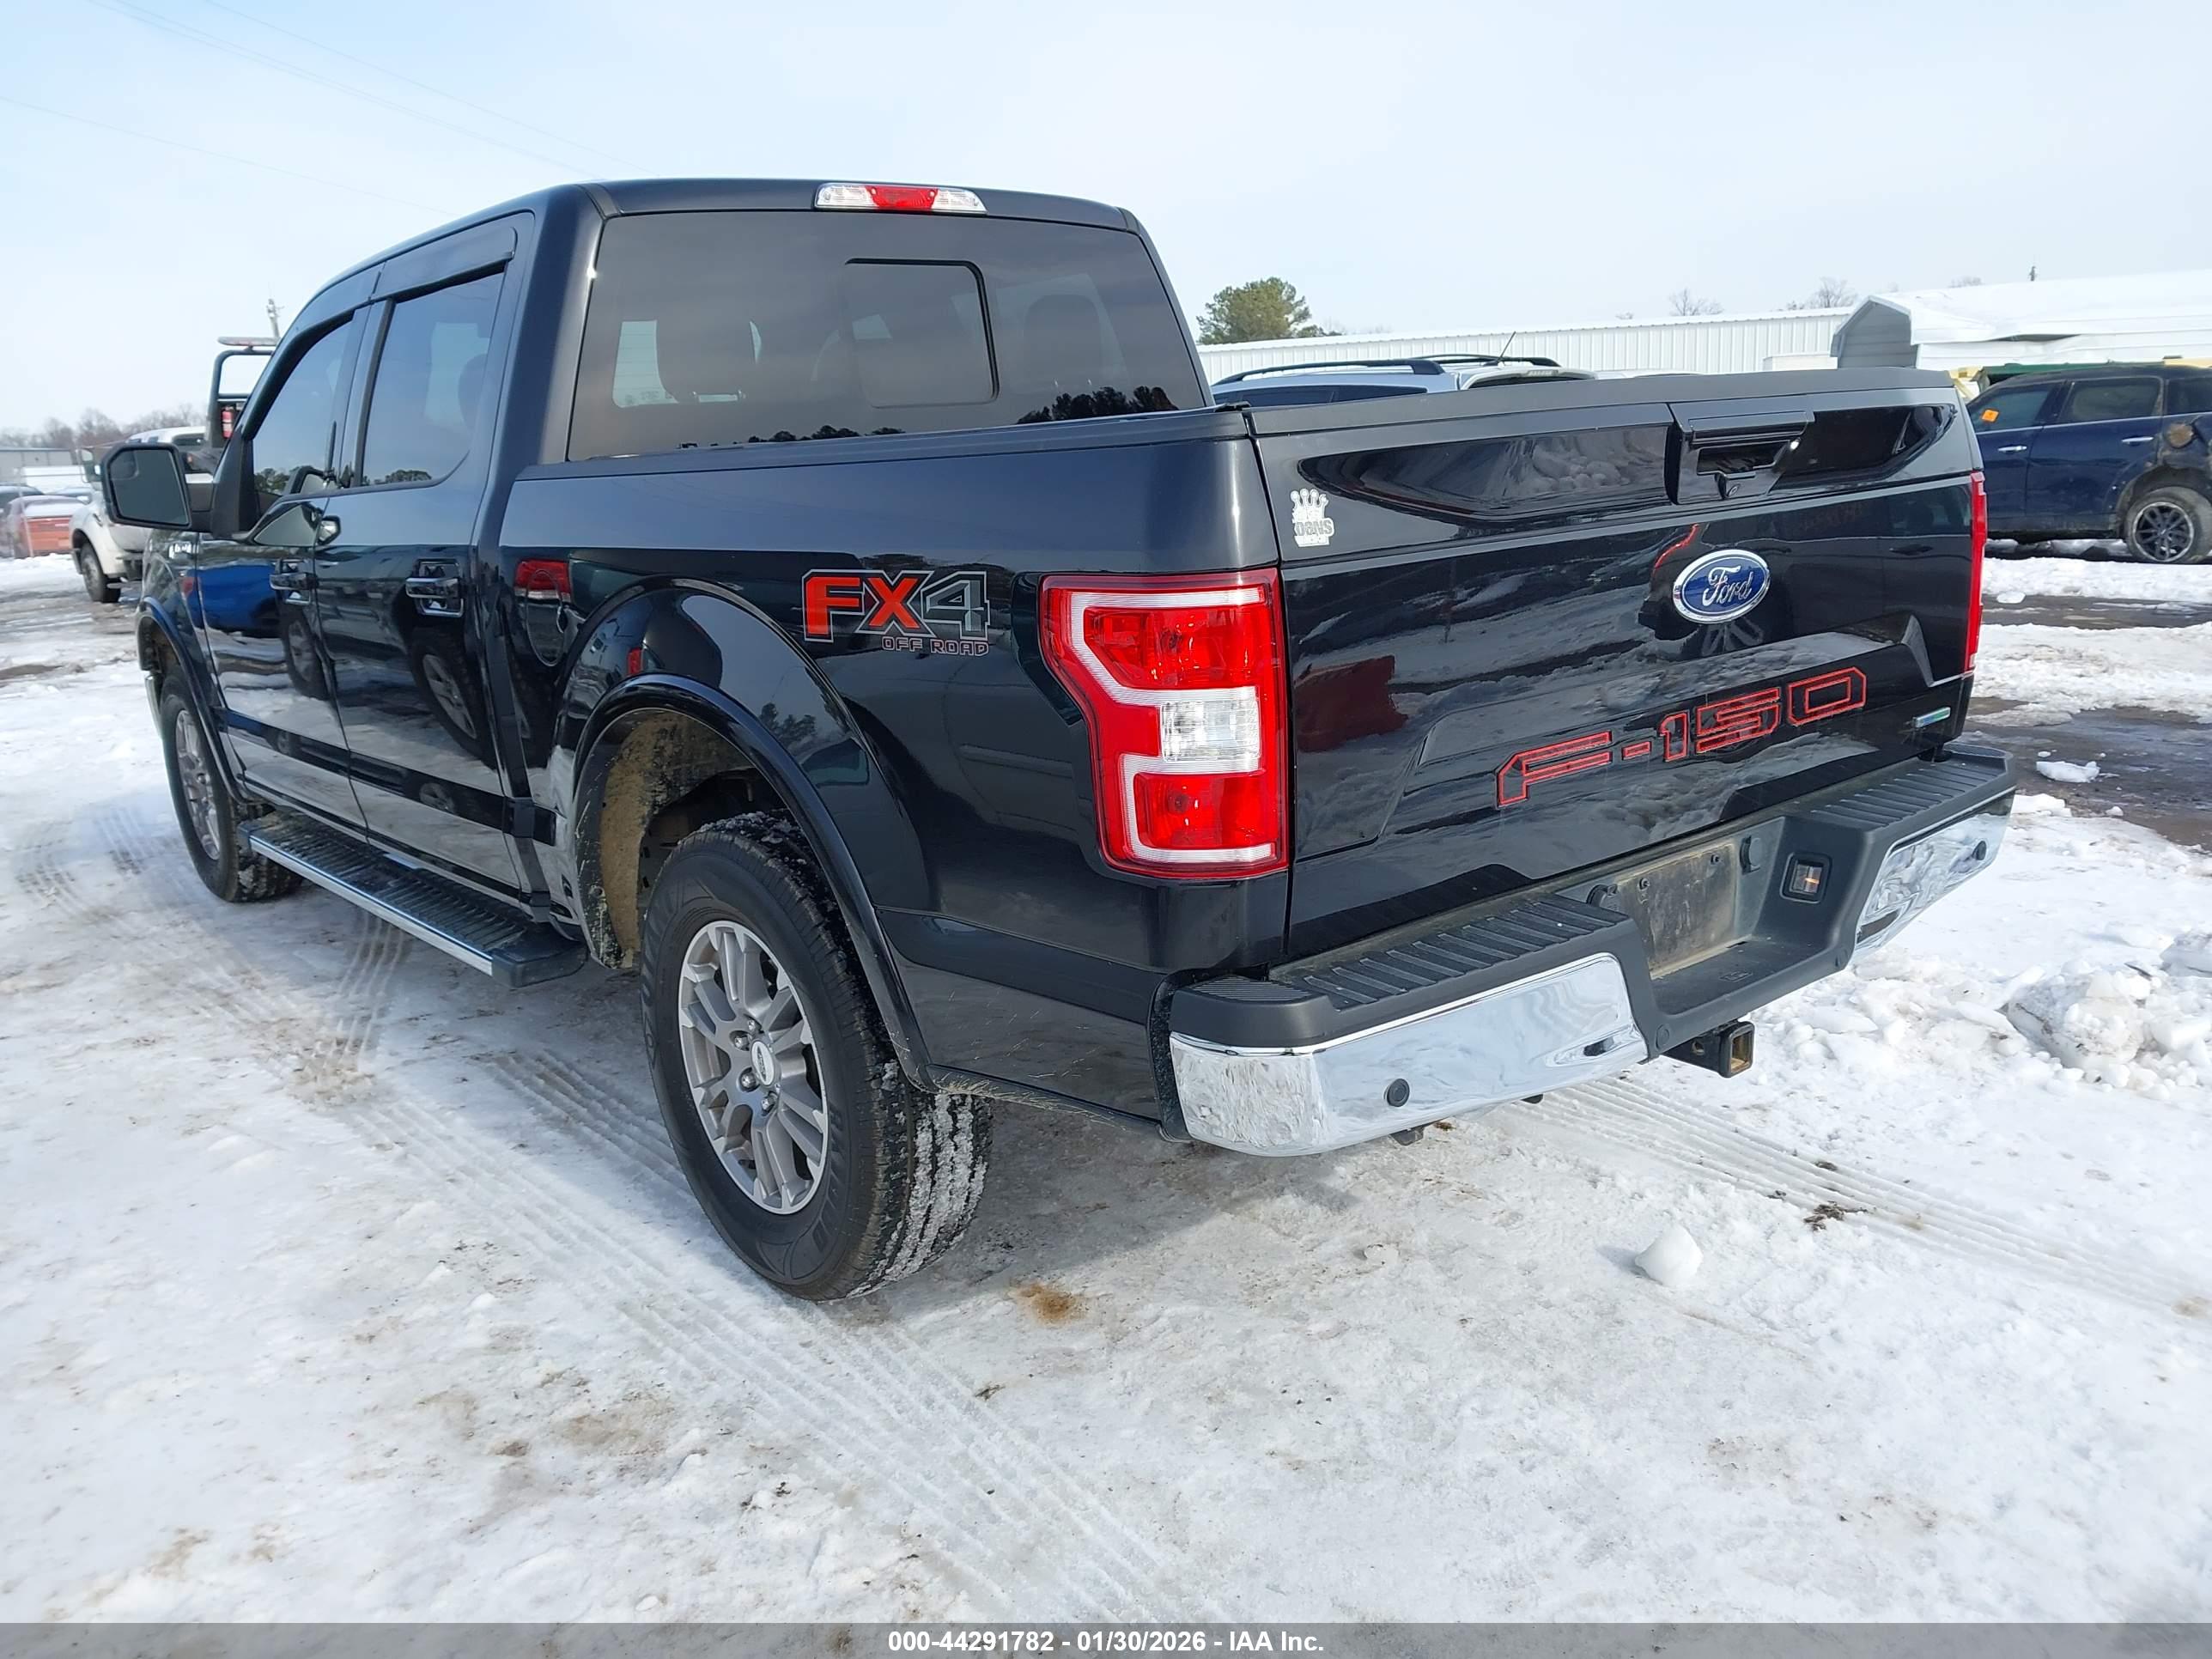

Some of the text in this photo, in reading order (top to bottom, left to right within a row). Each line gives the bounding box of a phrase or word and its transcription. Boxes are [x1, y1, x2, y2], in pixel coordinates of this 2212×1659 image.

[802, 568, 991, 642] FX4
[1702, 565, 1753, 606] Ford
[881, 636, 989, 656] OFF ROAD
[1497, 665, 1867, 808] F-150
